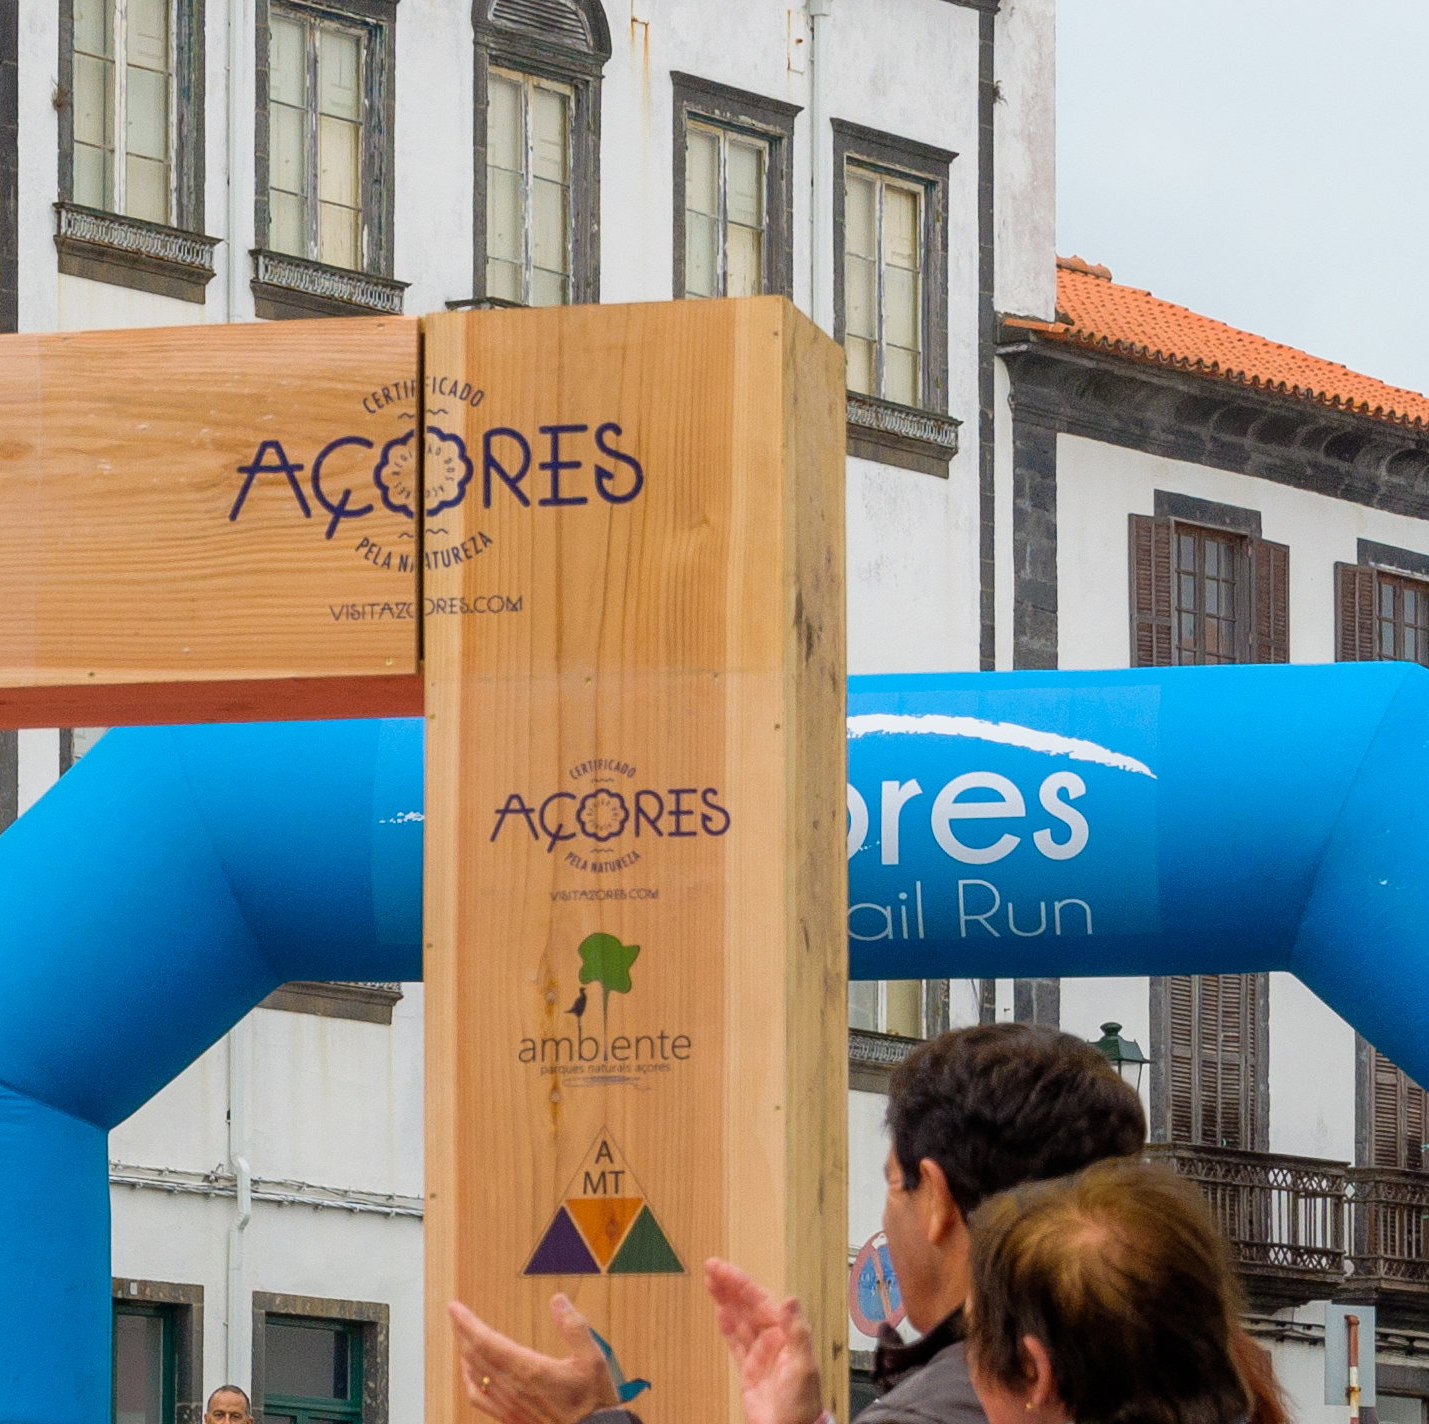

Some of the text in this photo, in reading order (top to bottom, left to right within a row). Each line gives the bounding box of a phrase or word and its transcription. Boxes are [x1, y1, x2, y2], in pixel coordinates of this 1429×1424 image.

[362, 376, 485, 414] CERTIFICADO
[228, 422, 644, 540] AÇORES
[354, 530, 494, 573] PELA NATUREZA
[329, 594, 524, 622] VISITAZORES.COM
[569, 758, 637, 780] CERTIFICADO
[490, 787, 731, 853] AÇORES
[848, 771, 1090, 866] res
[564, 850, 641, 873] PELA NATUREZA
[848, 878, 1093, 941] ail Run
[517, 1026, 692, 1063] ambiente
[594, 1140, 614, 1164] A
[582, 1170, 625, 1195] MT
